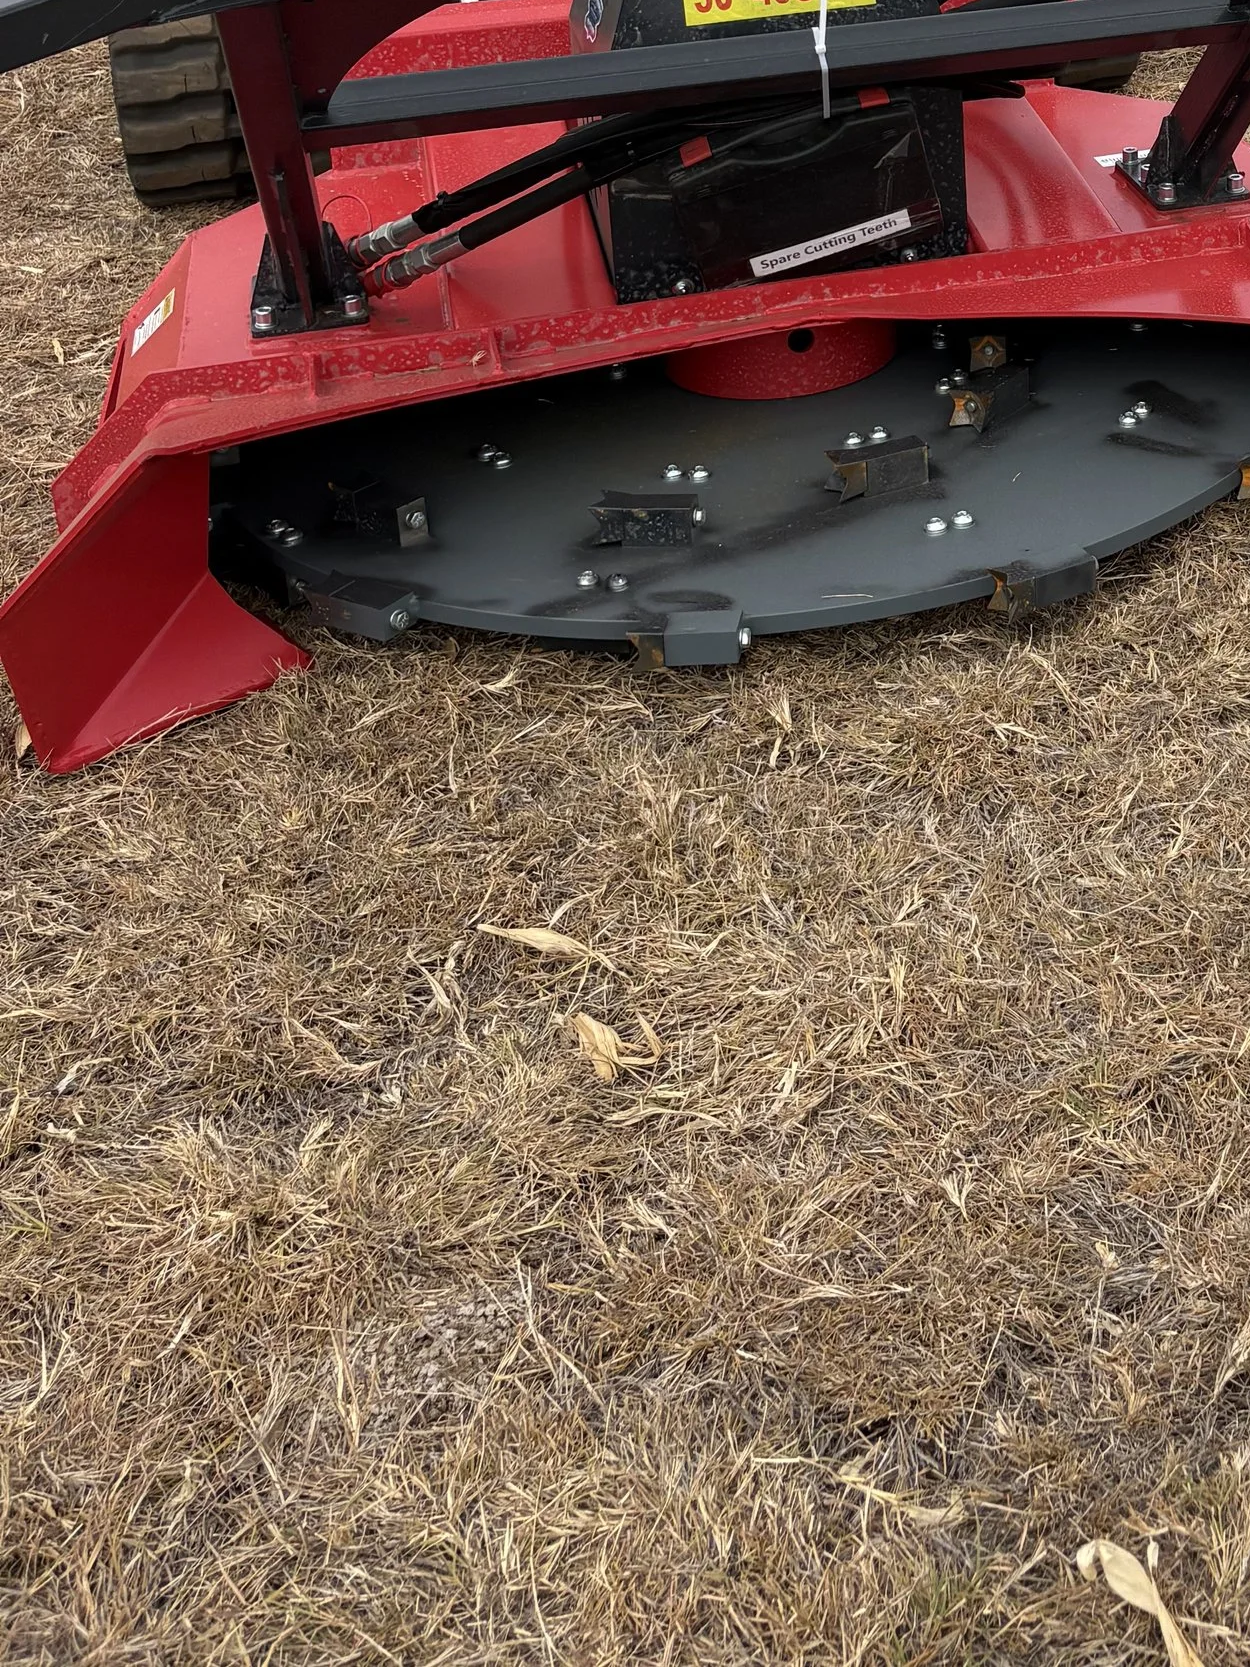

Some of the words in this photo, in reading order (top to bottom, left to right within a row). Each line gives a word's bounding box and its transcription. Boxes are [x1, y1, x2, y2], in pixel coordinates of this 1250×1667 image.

[760, 251, 801, 270] Spare
[804, 232, 857, 255] Cutting
[859, 218, 897, 237] Teeth
